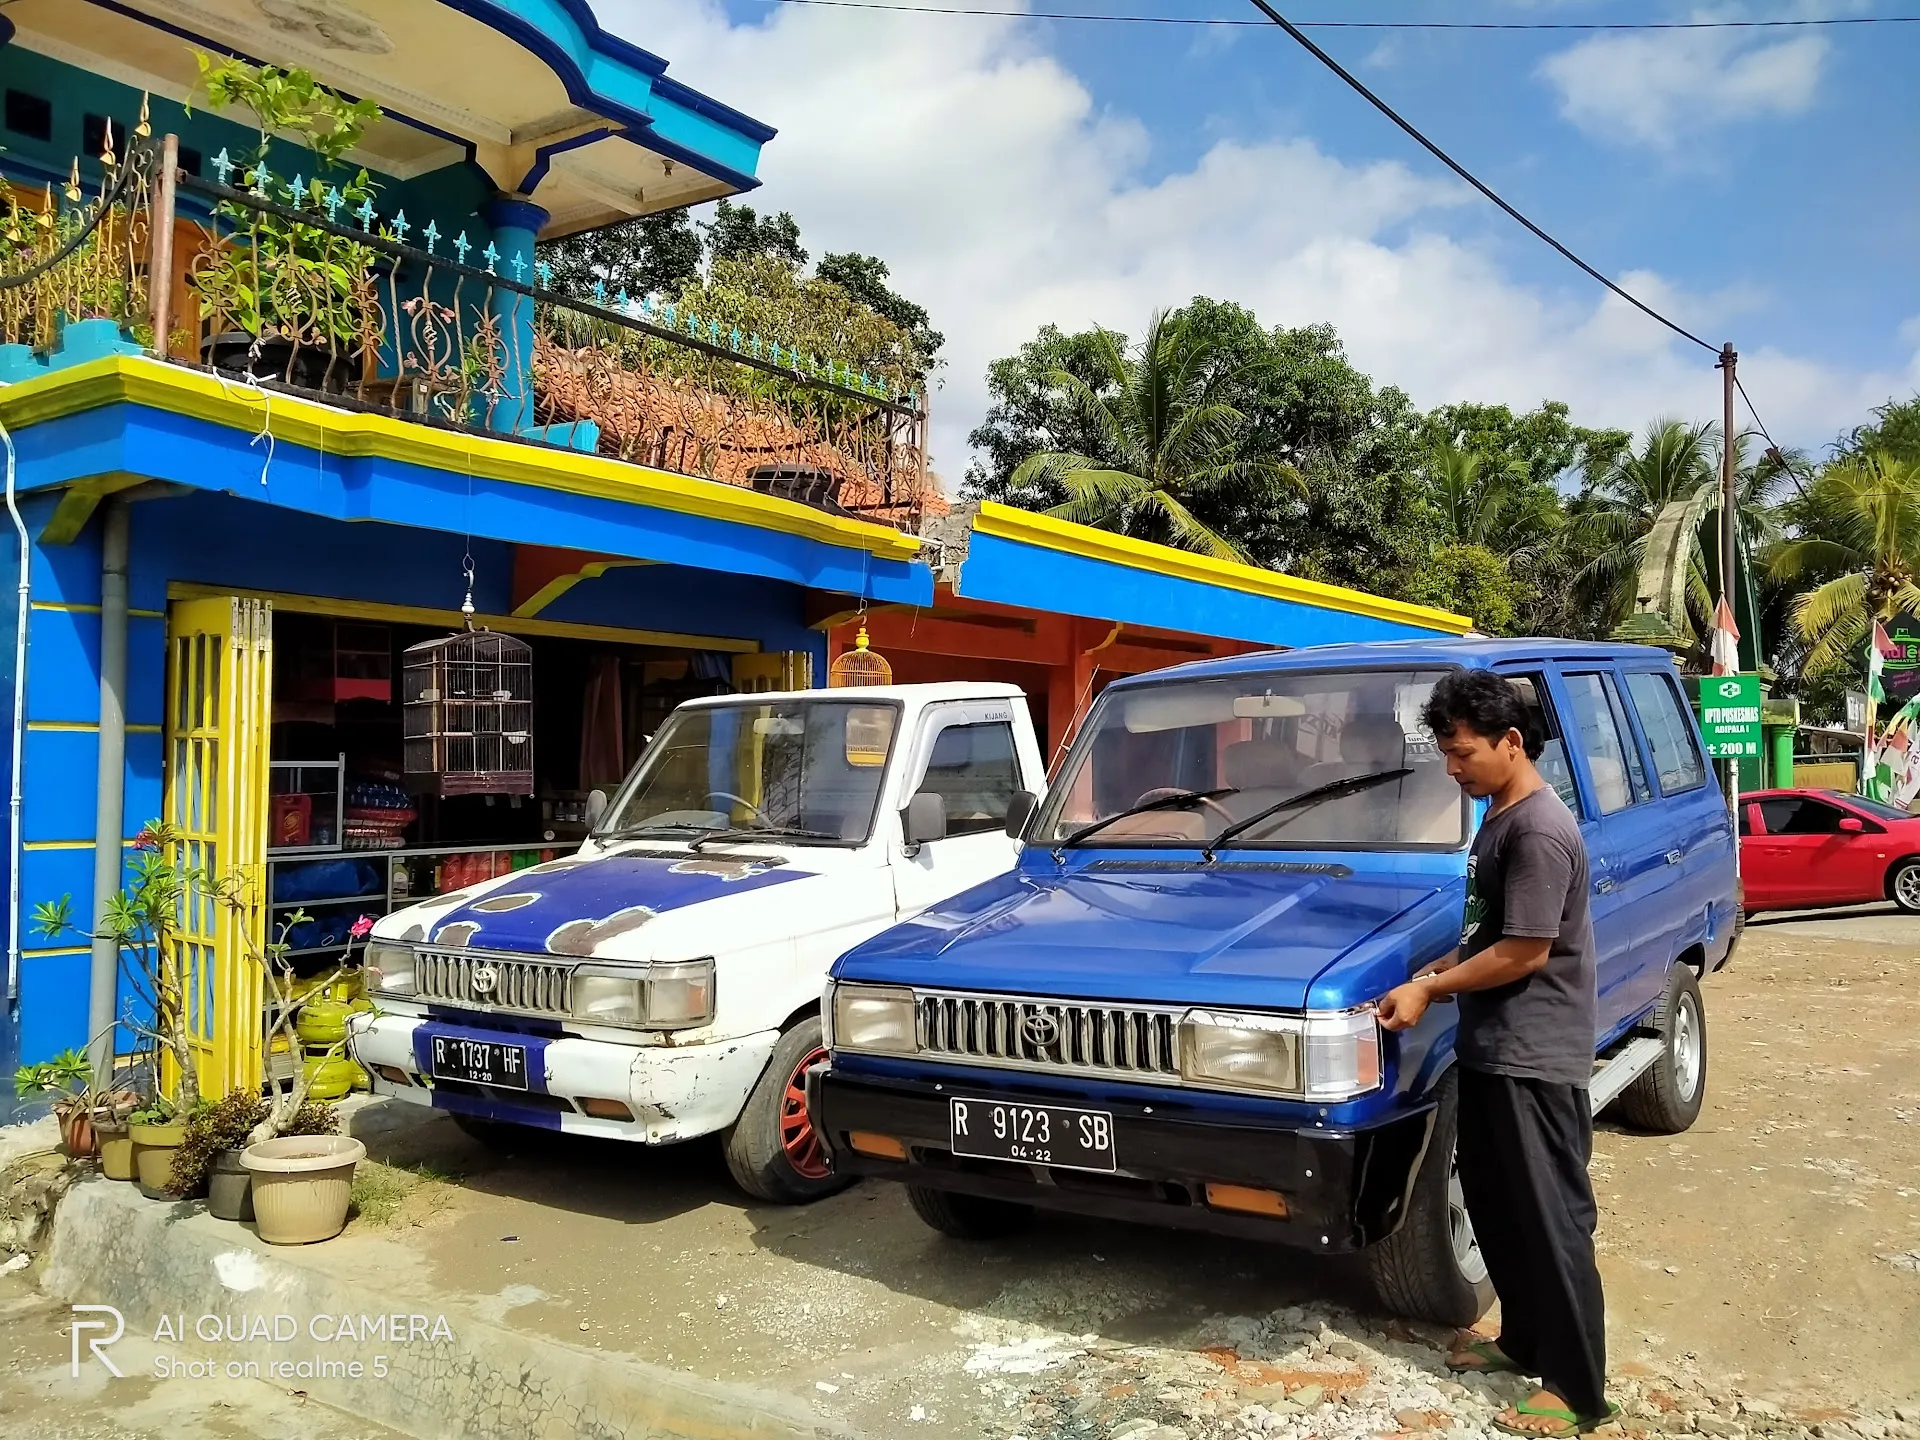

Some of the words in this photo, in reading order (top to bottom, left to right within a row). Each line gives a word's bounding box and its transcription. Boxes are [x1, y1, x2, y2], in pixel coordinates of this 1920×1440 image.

[984, 711, 1007, 720] KIJANG
[1721, 706, 1759, 723] PUSKESMAS
[1715, 725, 1745, 734] ADIPALA
[1720, 742, 1743, 755] 200
[1745, 741, 1757, 754] M
[435, 1039, 445, 1064] R
[459, 1041, 490, 1069] 1737
[503, 1046, 520, 1073] HF
[954, 1102, 969, 1136] R
[993, 1106, 1050, 1144] 9123
[1078, 1114, 1109, 1151] SB
